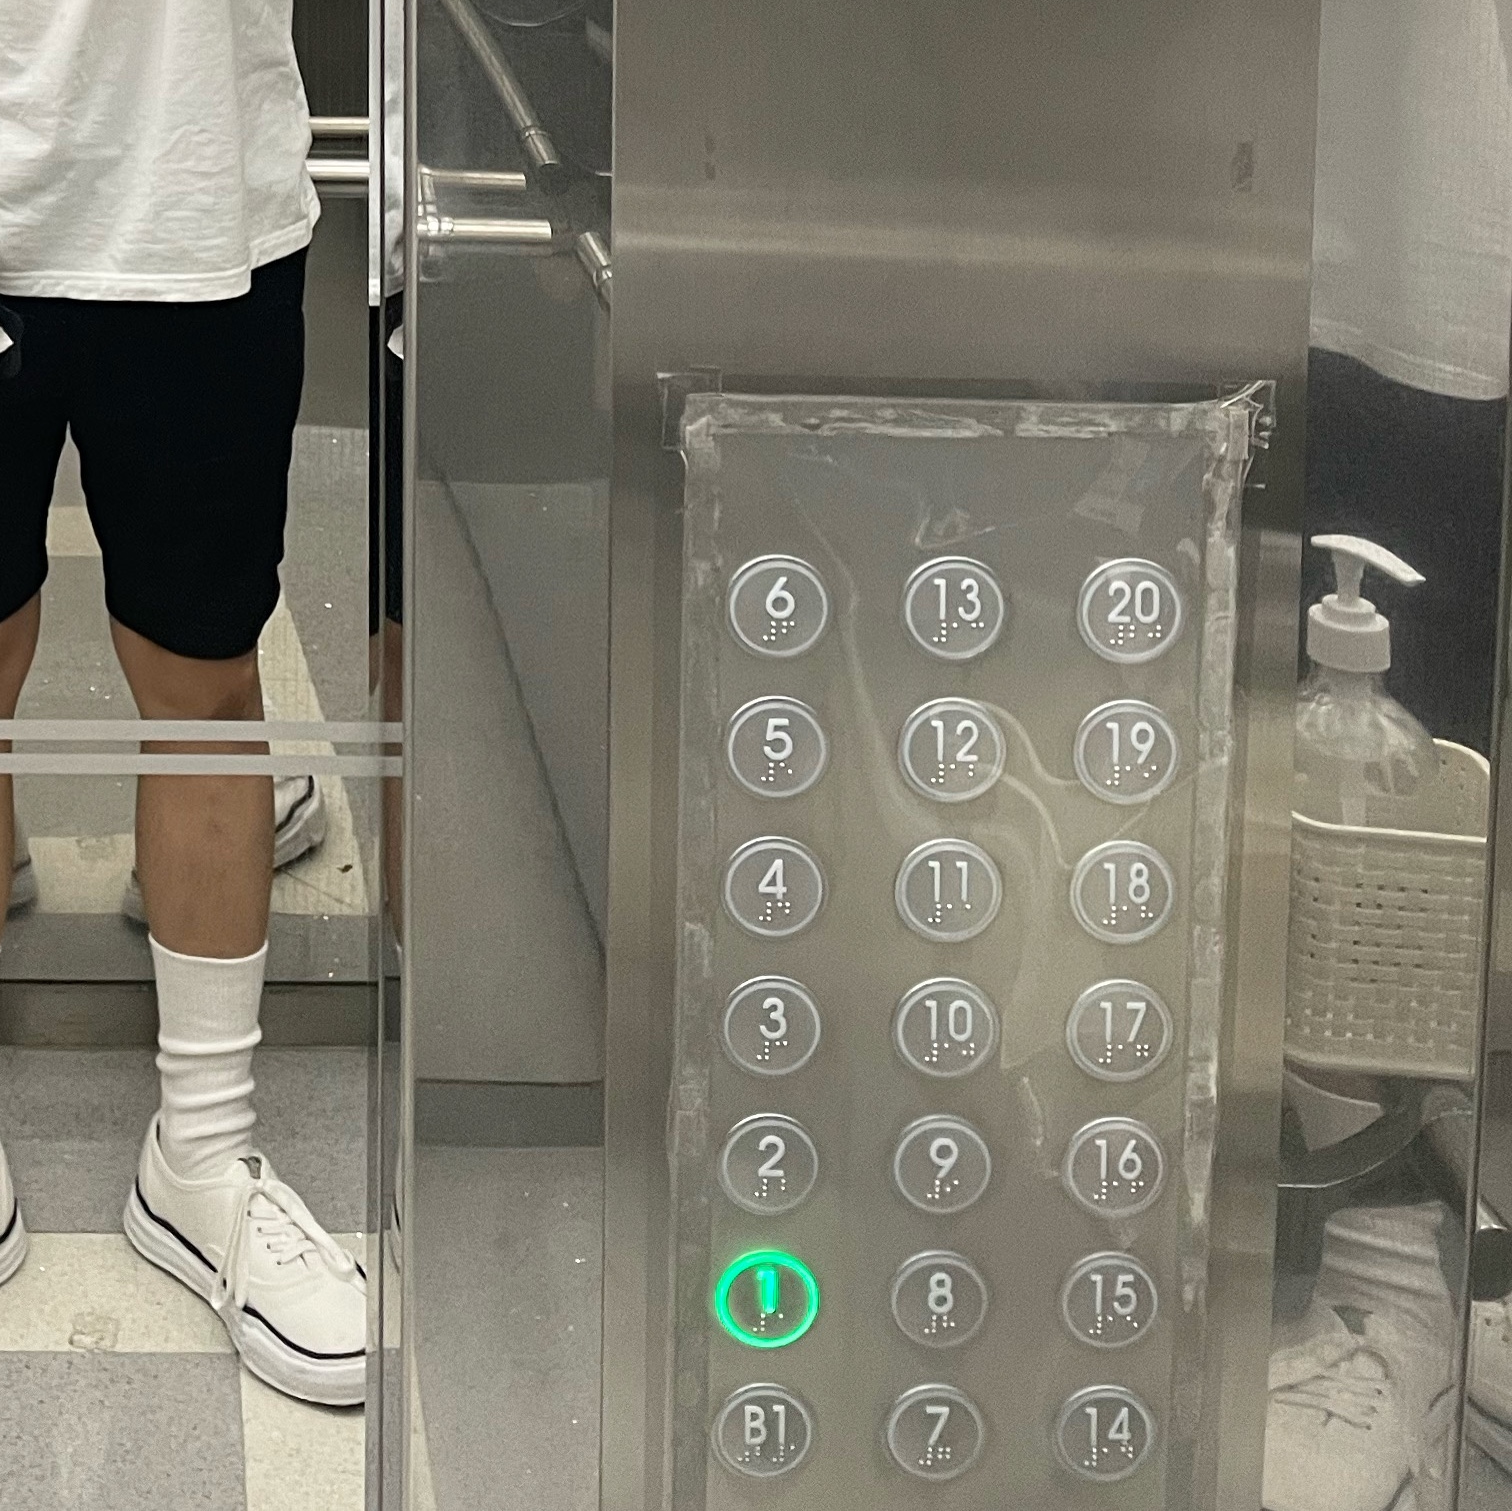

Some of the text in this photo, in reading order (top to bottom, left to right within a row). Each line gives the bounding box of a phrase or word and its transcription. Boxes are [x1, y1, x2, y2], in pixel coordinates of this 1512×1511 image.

[765, 577, 1160, 624] 6 13 20
[764, 718, 1155, 765] 5 12 19
[758, 859, 1151, 904] 4 11 18
[759, 997, 1147, 1043] 3 10 17
[758, 1135, 1142, 1180] 2 9 16
[756, 1266, 1138, 1315] 1 8 15
[744, 1404, 1131, 1447] B1 7 14
